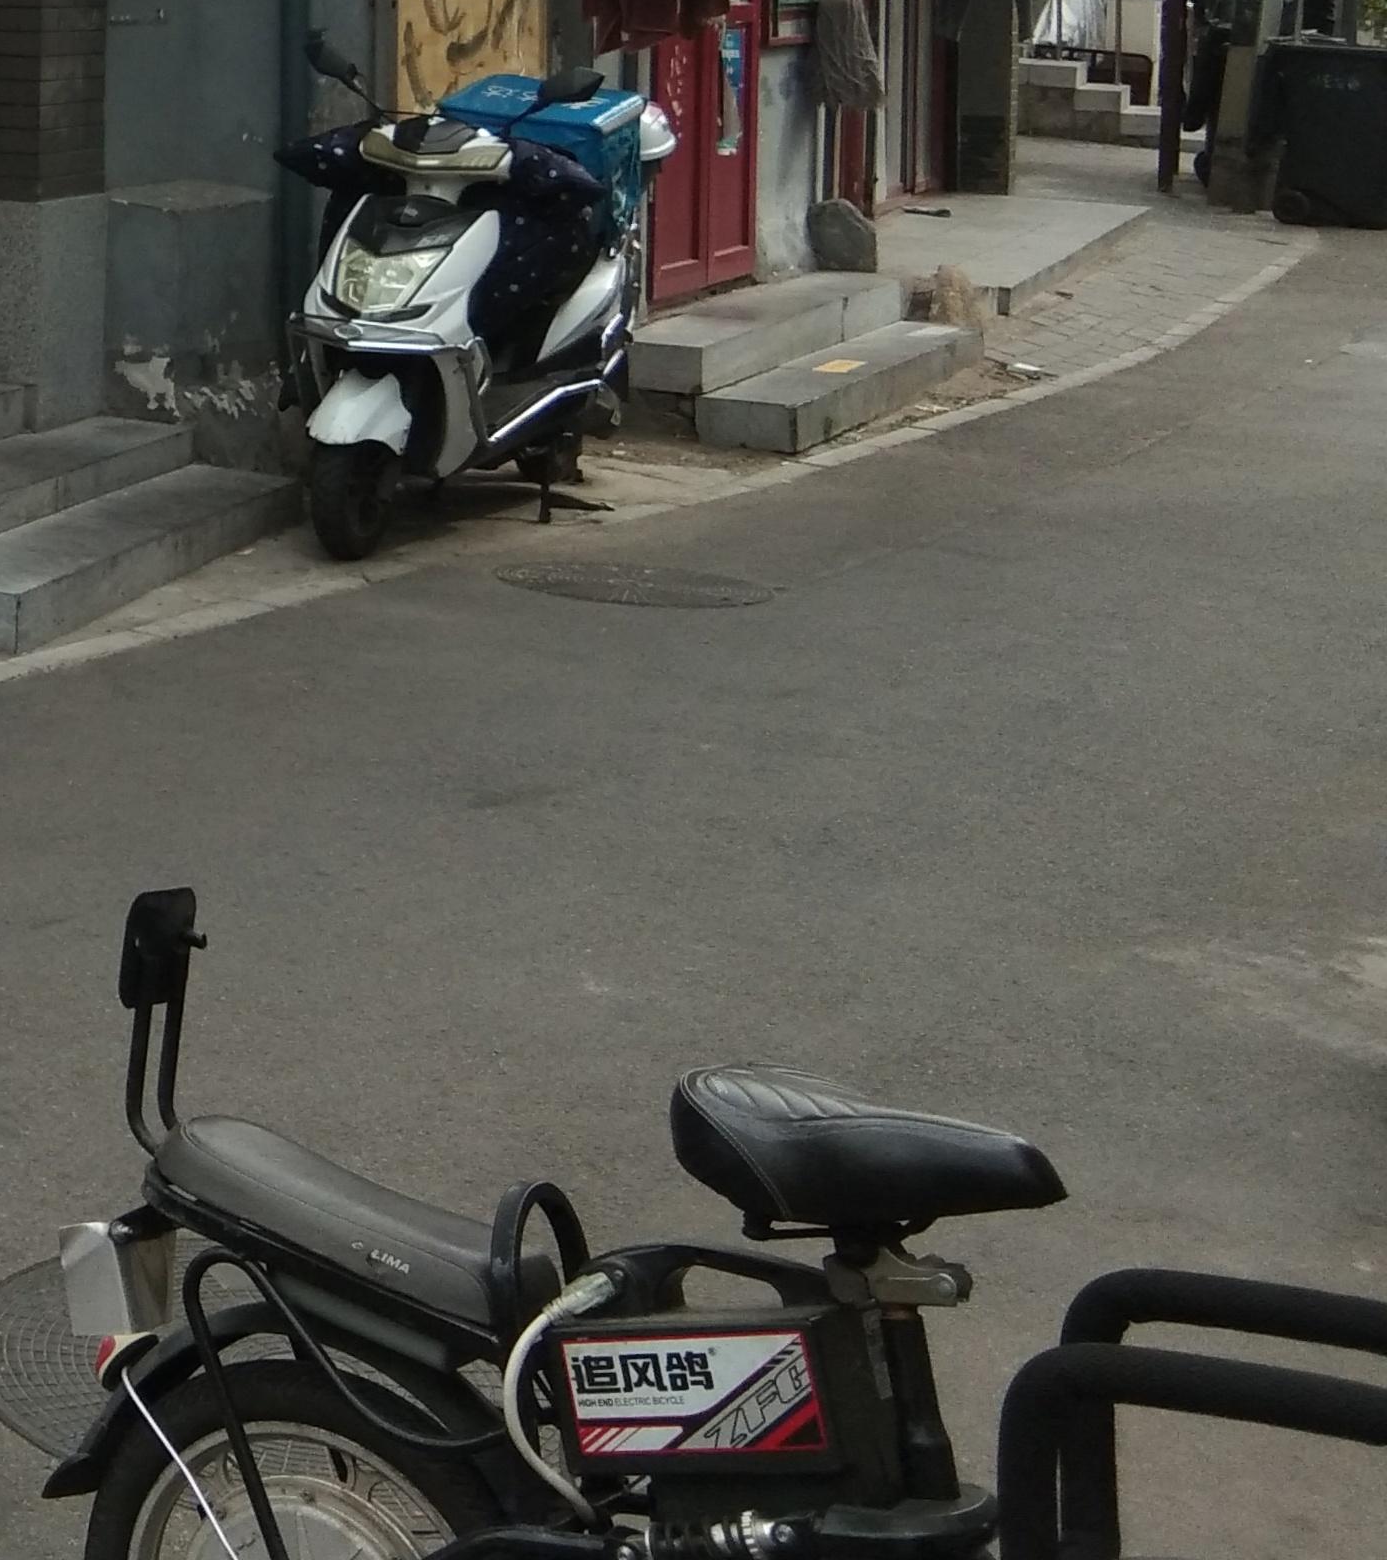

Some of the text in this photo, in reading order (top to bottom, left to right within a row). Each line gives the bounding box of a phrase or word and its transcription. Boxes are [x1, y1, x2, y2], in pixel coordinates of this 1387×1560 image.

[571, 1351, 715, 1395] 追风鸽
[578, 1395, 685, 1407] HIGH END ELECTRIC BICYCLE
